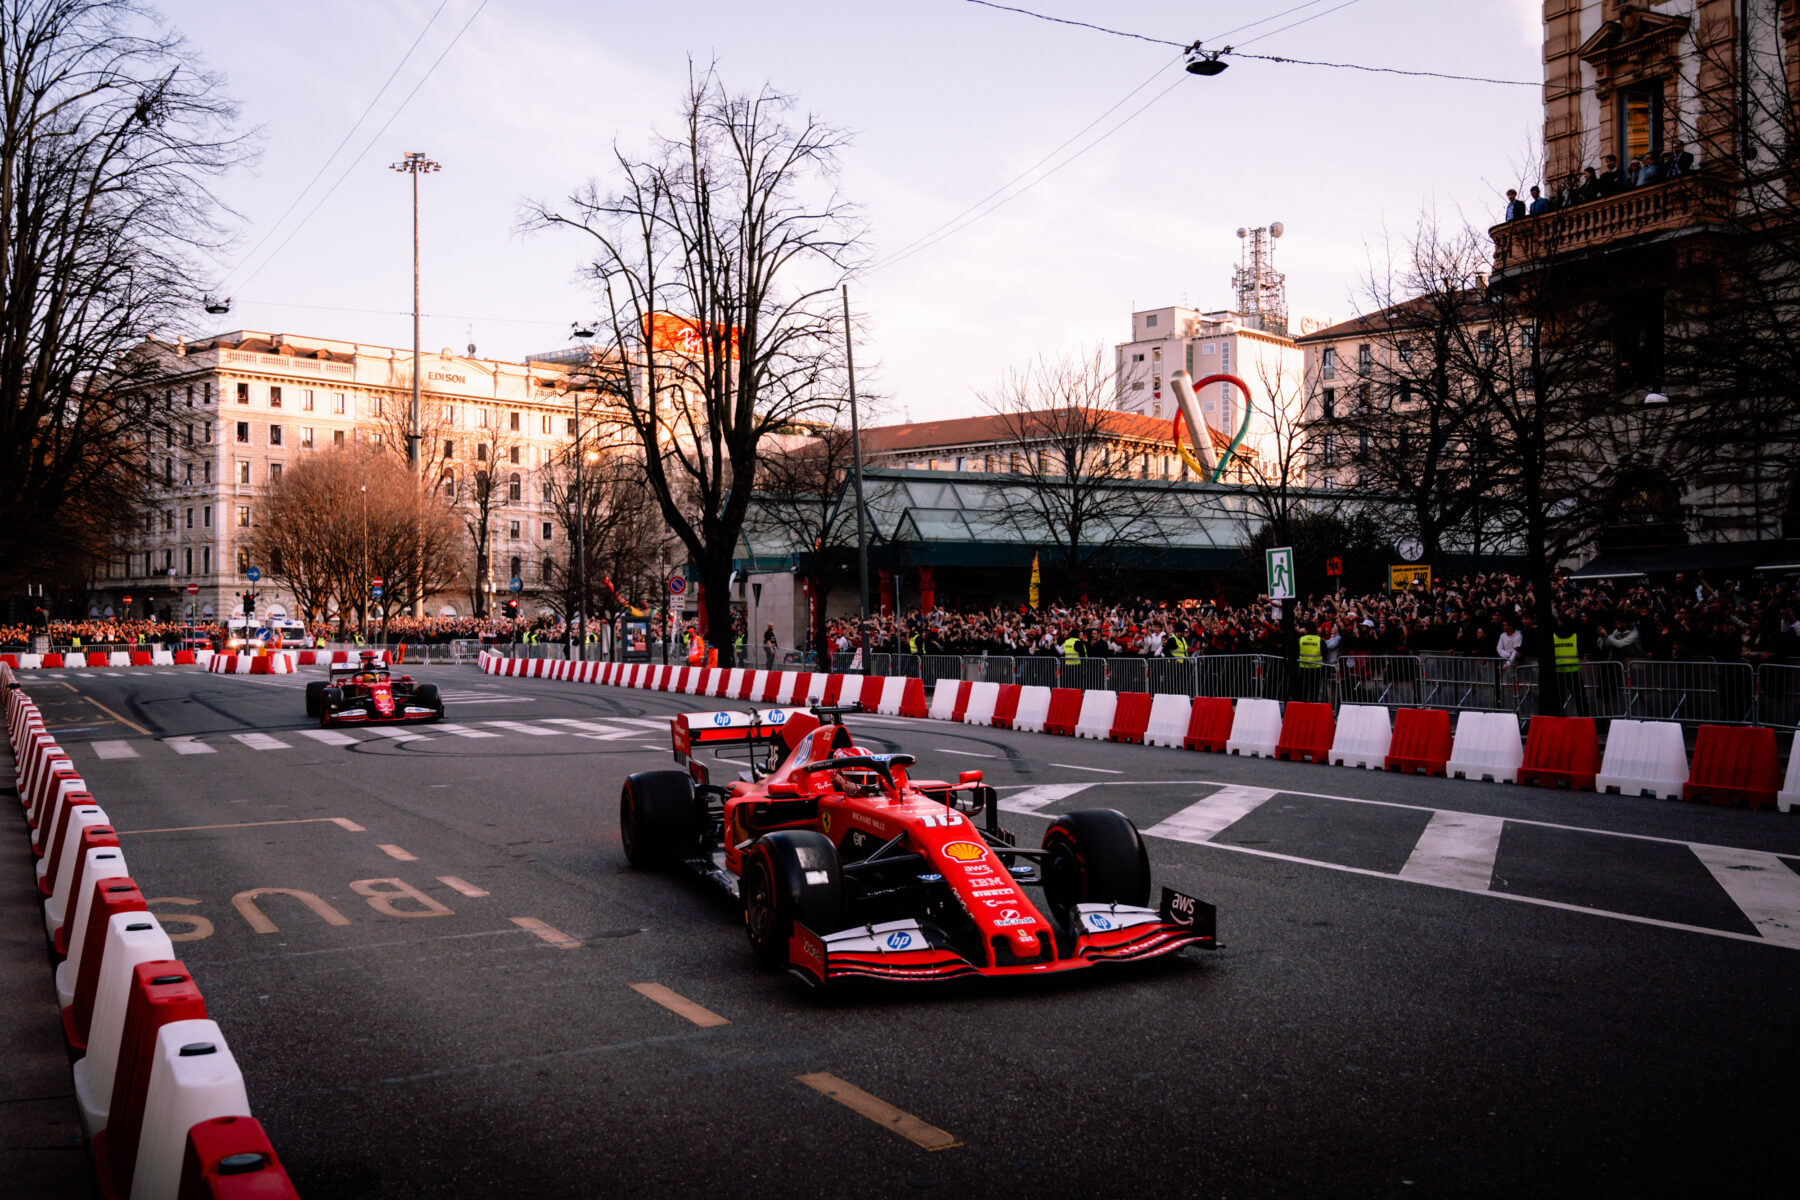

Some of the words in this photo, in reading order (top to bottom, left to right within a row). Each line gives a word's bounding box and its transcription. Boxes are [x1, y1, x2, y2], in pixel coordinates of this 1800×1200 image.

[428, 371, 466, 384] EDISON
[716, 711, 730, 726] hp
[770, 709, 784, 724] hp
[852, 812, 871, 826] RICHARD
[915, 813, 963, 828] 16
[964, 864, 990, 873] aws
[968, 877, 1005, 888] IBM
[147, 877, 456, 942] BUS
[1171, 893, 1196, 915] aws
[993, 916, 1037, 927] UniCredit
[1093, 914, 1109, 929] hp
[891, 932, 910, 949] hp
